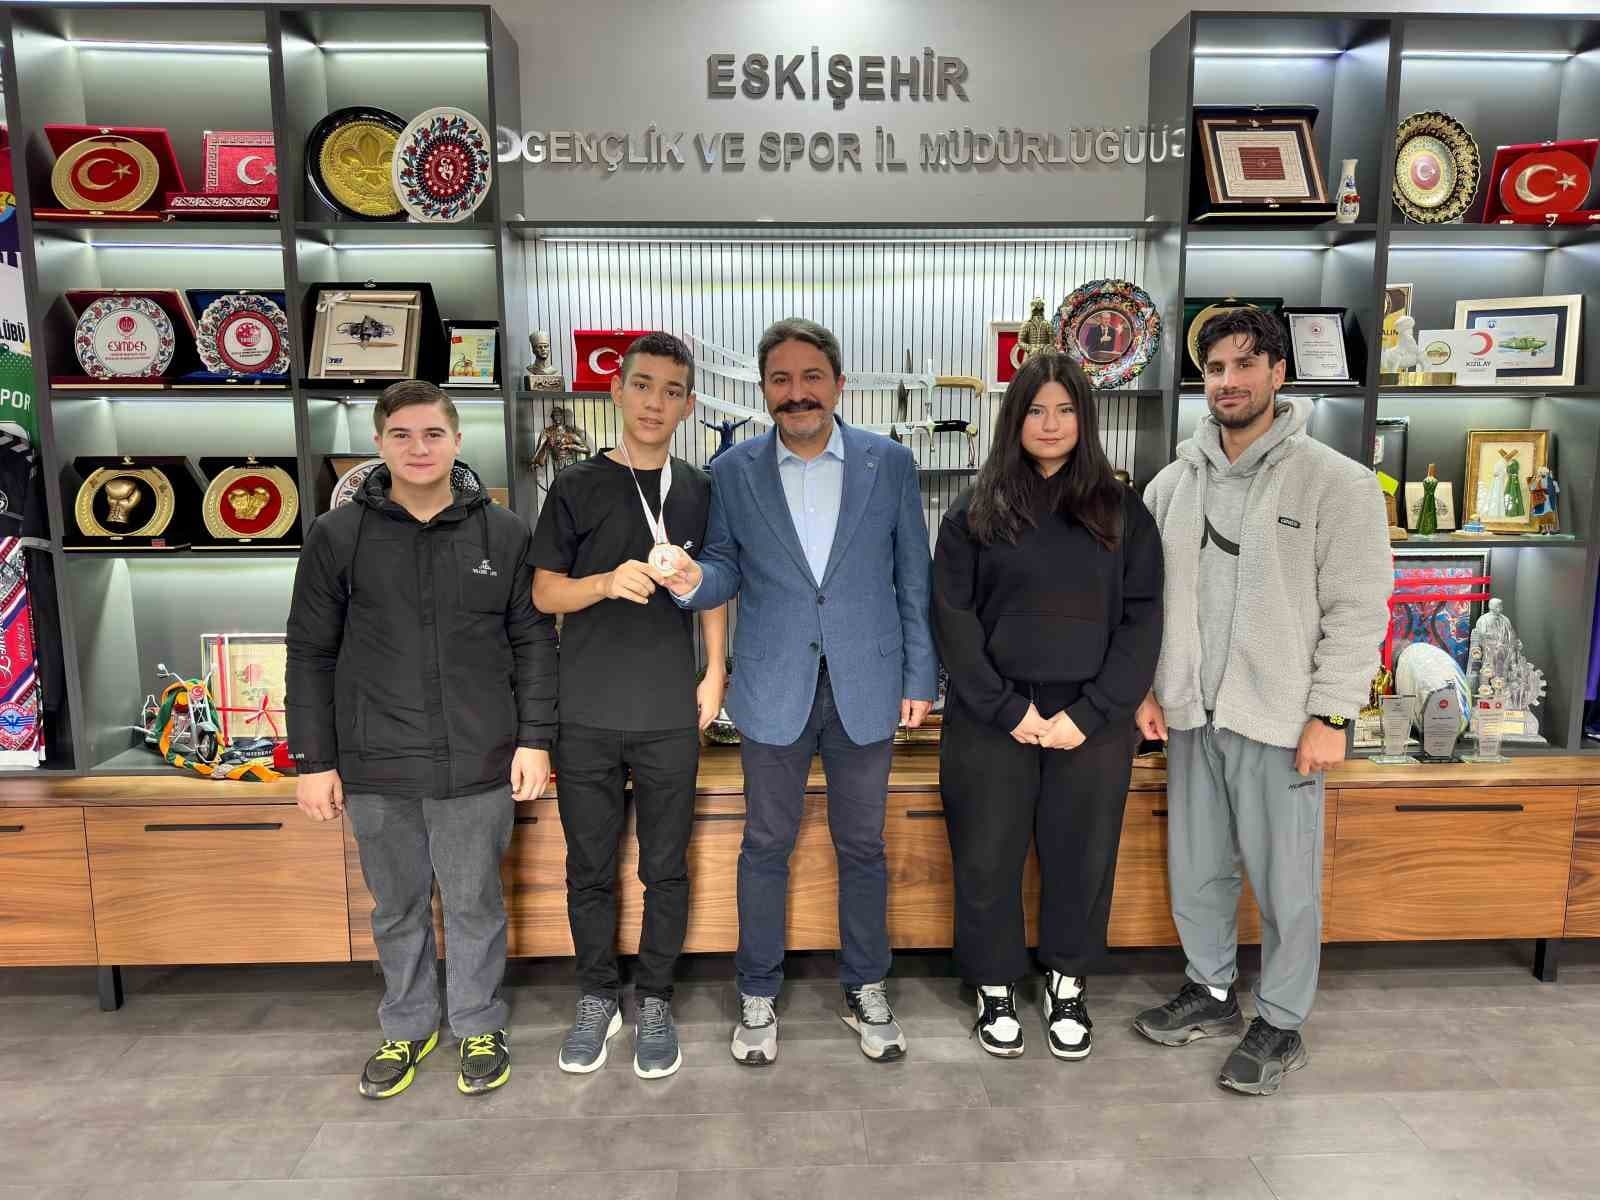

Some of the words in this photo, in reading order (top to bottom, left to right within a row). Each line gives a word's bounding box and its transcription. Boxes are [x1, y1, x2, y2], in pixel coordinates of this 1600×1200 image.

[706, 45, 969, 110] ESKİŞEHİR
[521, 121, 685, 173] GENÇLİK
[693, 131, 746, 170] VE
[758, 131, 862, 171] SPOR
[875, 125, 908, 171] İL
[919, 126, 1146, 171] MÜDÜRLÜĞÜ
